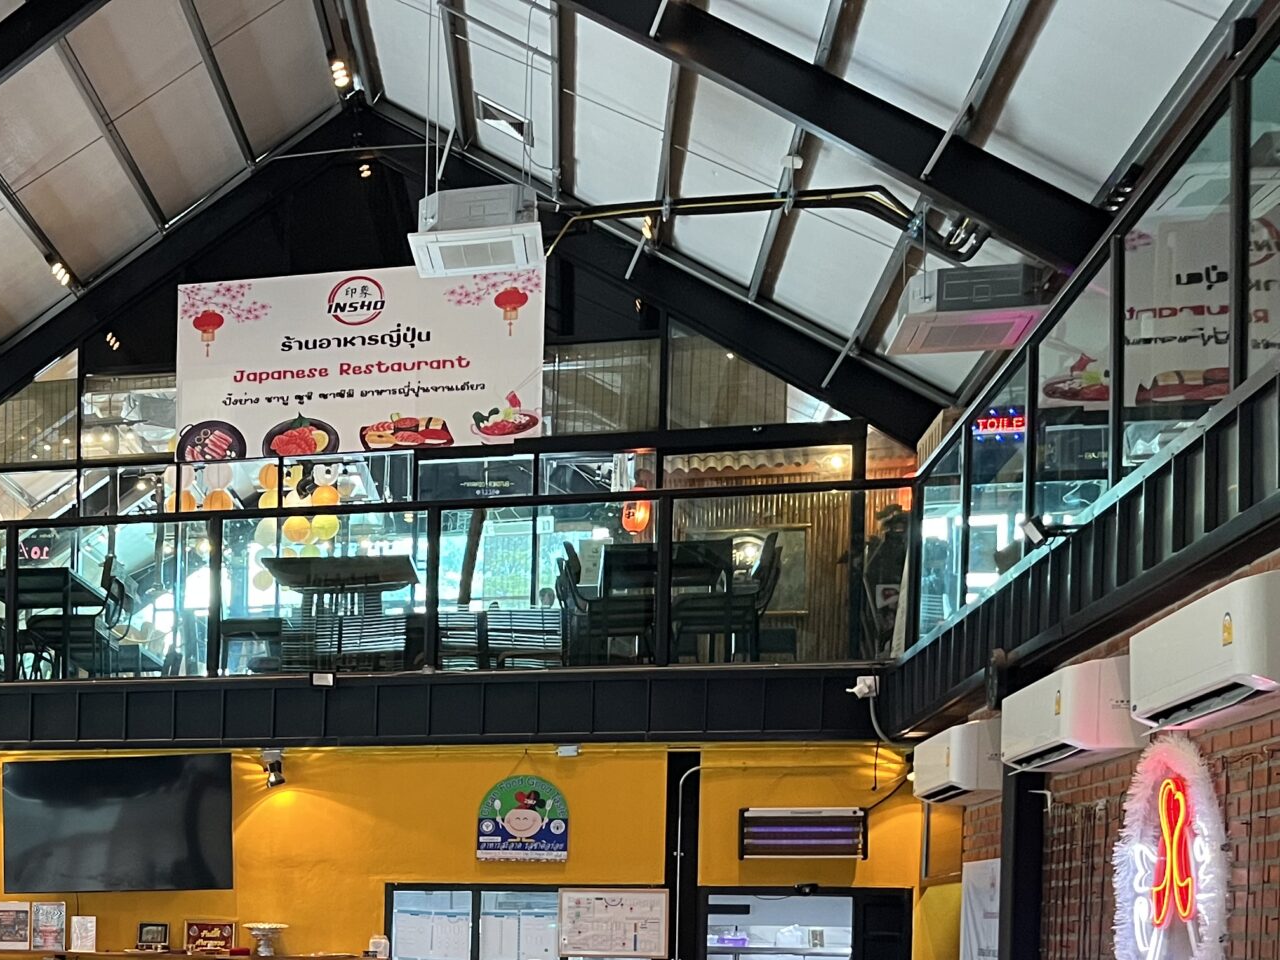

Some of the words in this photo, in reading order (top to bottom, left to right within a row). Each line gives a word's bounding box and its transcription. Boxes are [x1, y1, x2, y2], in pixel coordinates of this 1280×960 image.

[327, 300, 386, 314] INSHO
[281, 323, 431, 351] ร้านอาหารญี่ปุ่น
[233, 366, 329, 384] Japanese
[339, 355, 471, 376] Restaurant
[977, 417, 1025, 432] TOILE
